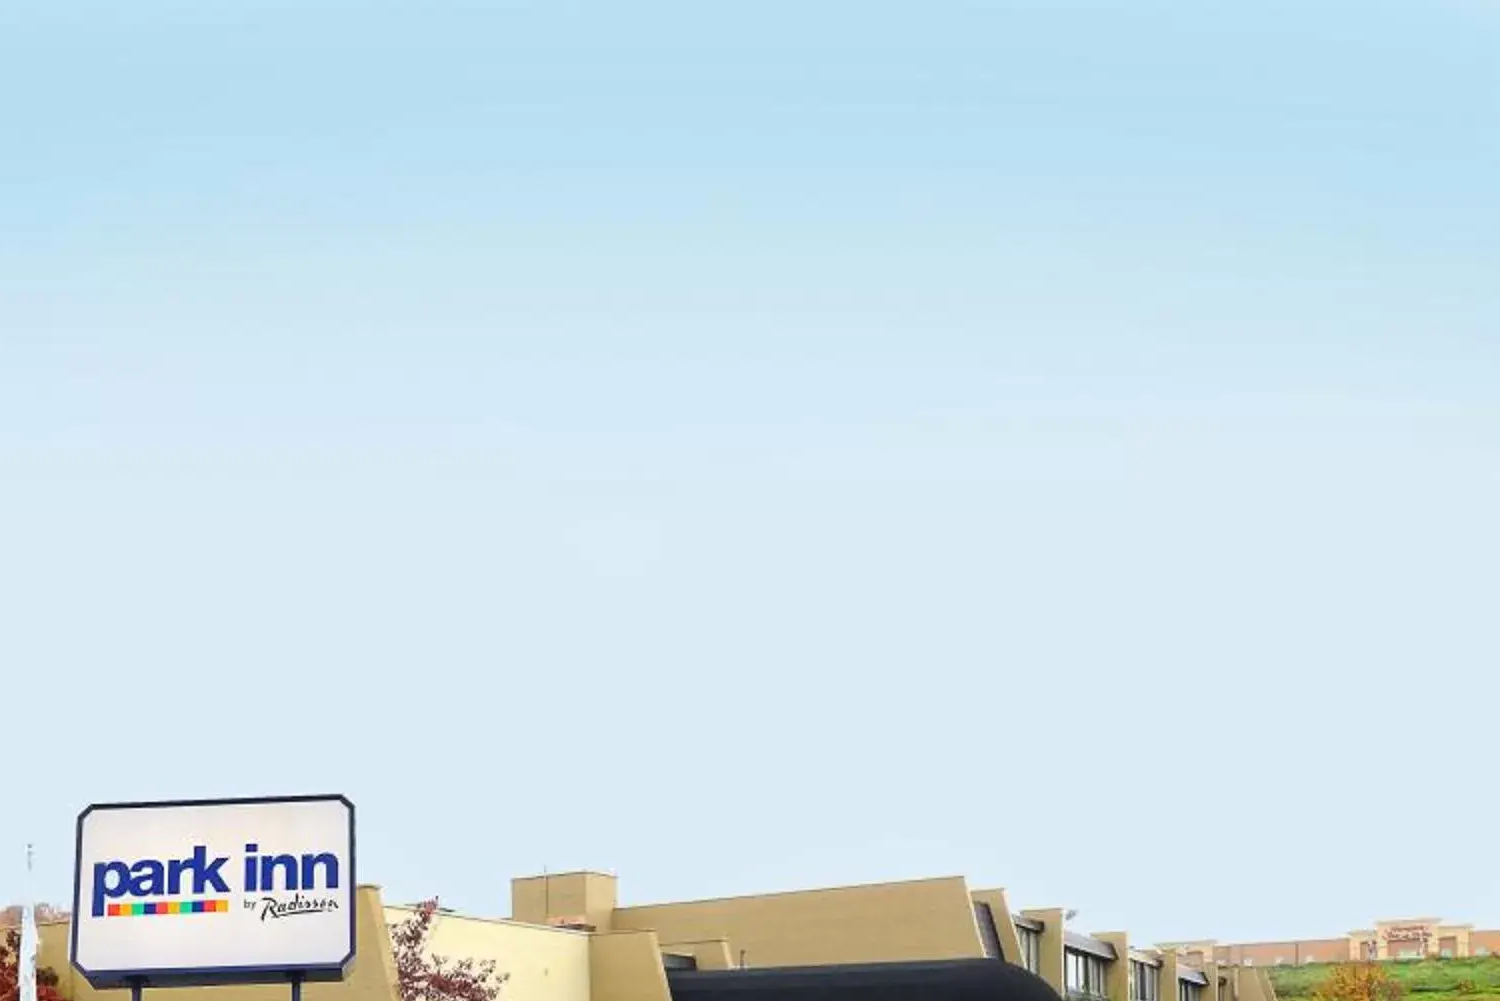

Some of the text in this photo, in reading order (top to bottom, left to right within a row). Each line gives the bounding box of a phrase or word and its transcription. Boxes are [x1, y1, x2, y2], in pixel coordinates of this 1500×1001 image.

[91, 843, 339, 917] park inn
[243, 893, 339, 921] by Radisson
